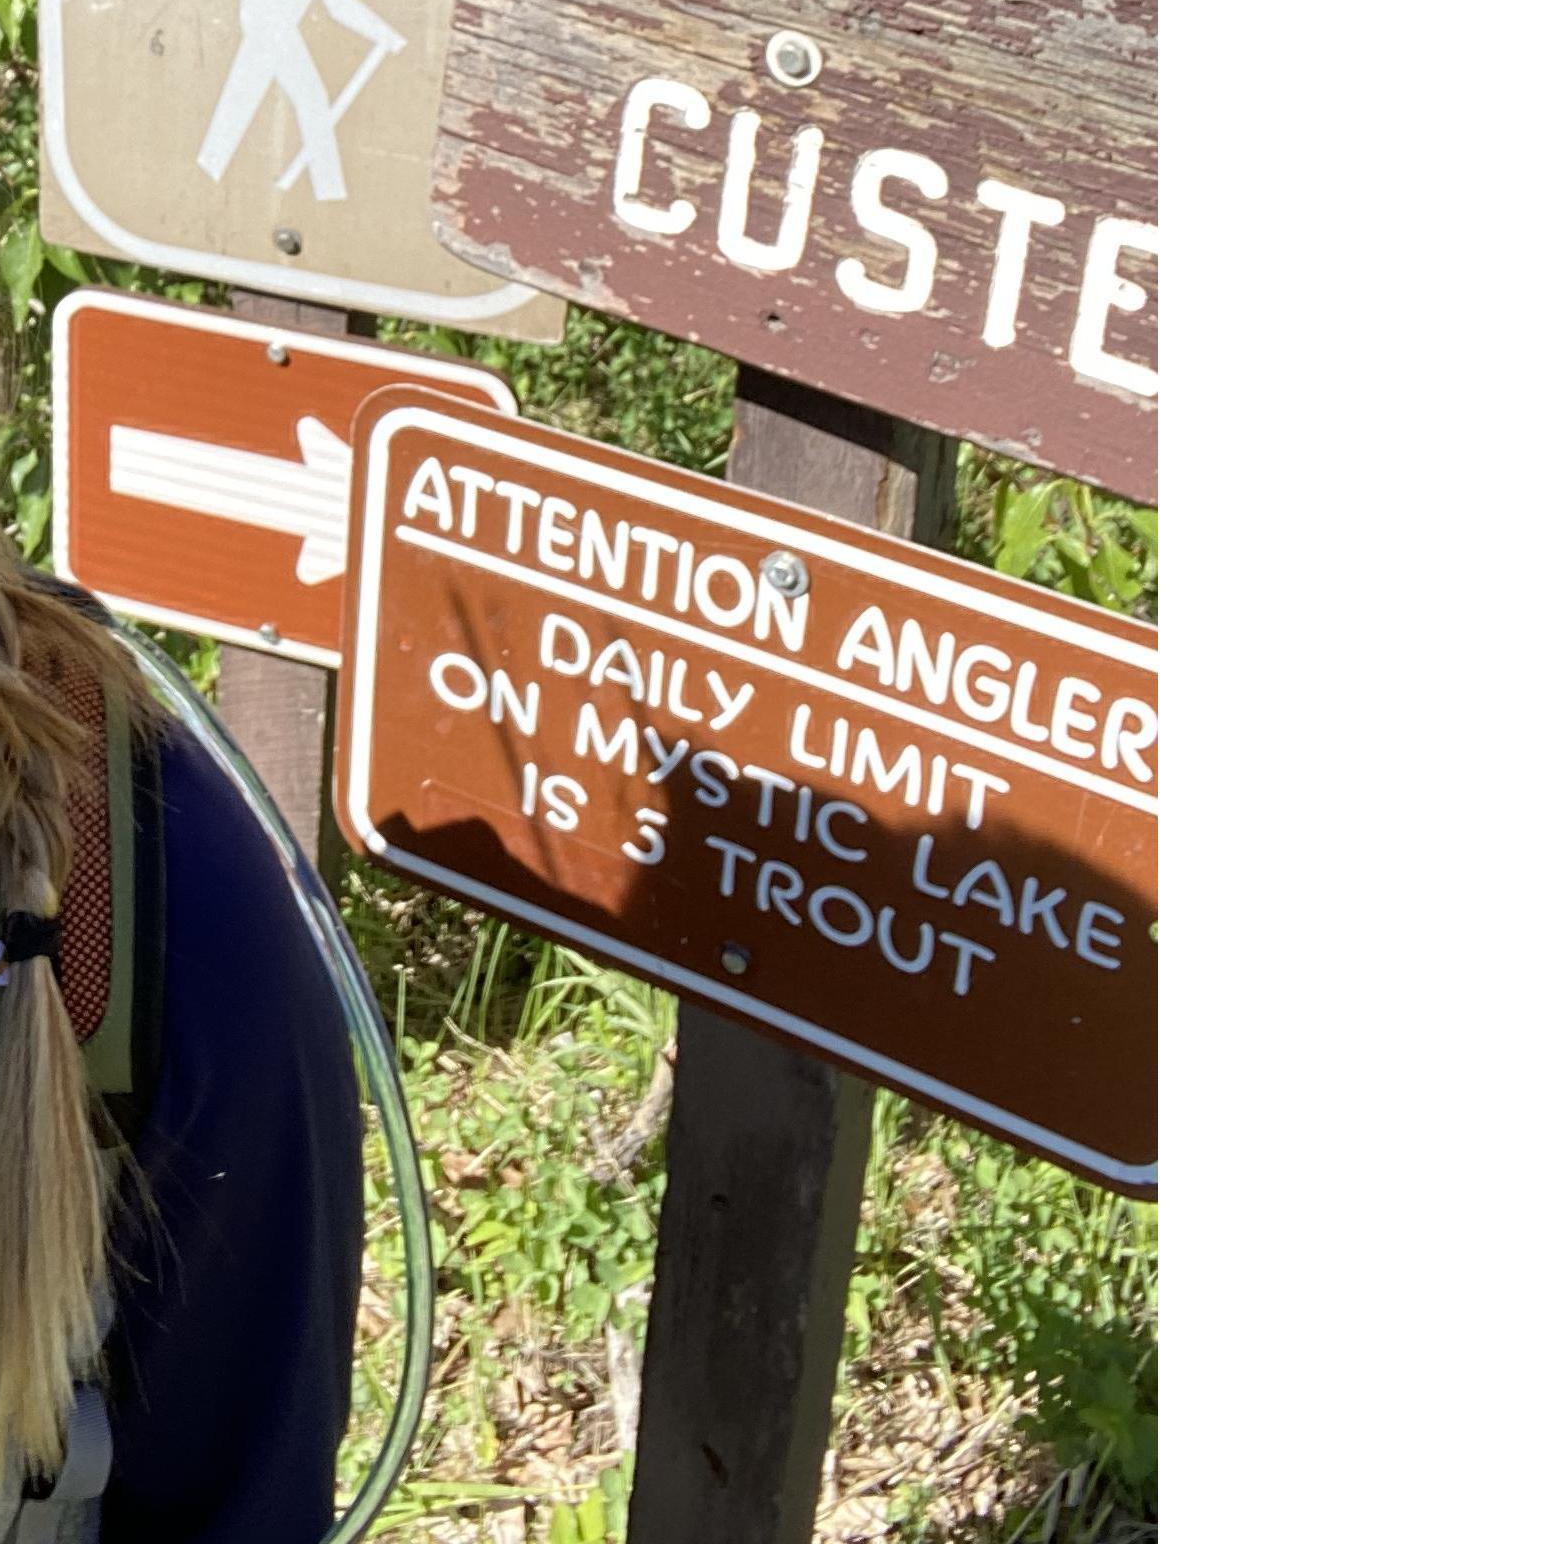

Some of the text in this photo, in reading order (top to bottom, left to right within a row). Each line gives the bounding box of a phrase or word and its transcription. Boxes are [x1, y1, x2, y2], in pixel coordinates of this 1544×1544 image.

[612, 78, 1158, 397] CUSTE
[403, 457, 1158, 784] ATTENTION ANGLER
[539, 613, 1010, 830] DAILY LIMIT
[429, 653, 1124, 971] ON MYSTIC LAKE
[521, 761, 588, 830] IS
[706, 836, 996, 995] TROUT
